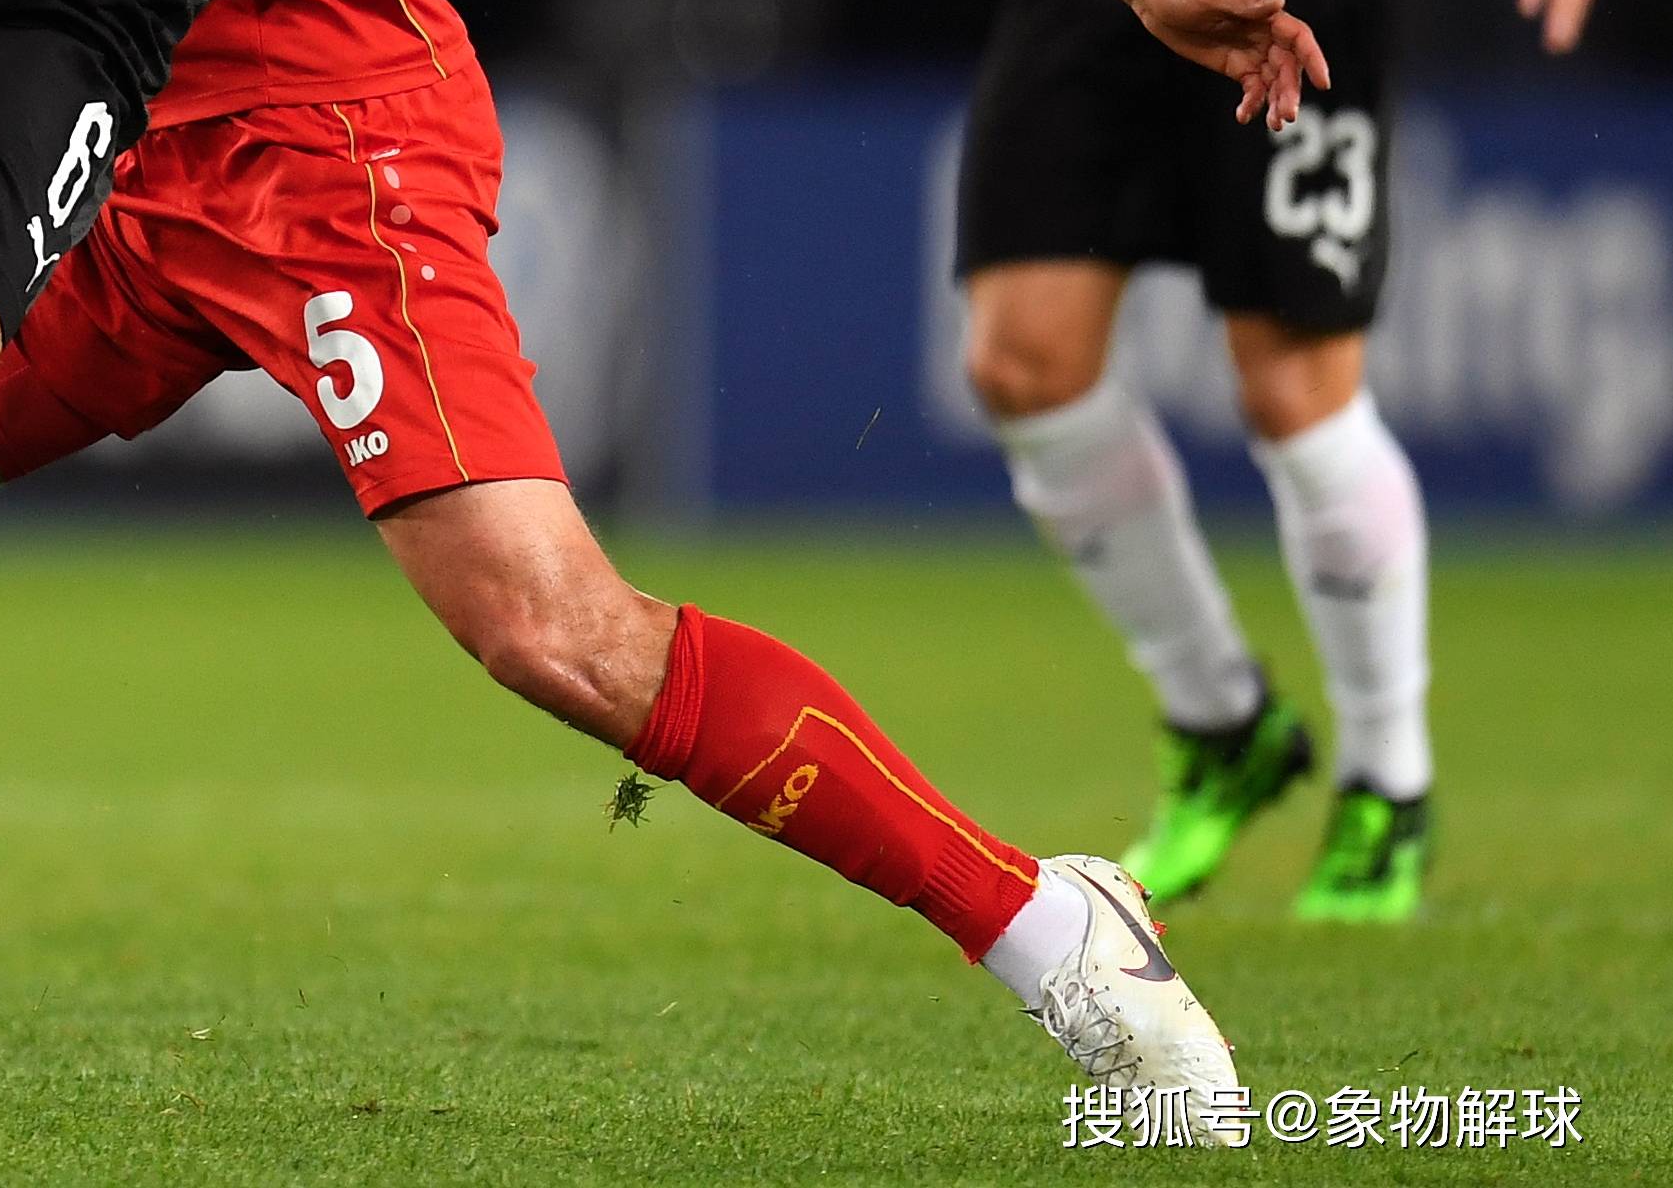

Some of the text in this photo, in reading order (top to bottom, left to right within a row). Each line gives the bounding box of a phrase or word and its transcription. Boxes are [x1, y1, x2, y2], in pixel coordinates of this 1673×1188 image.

[47, 102, 113, 228] 6
[1266, 106, 1378, 239] 23
[303, 291, 384, 430] 5
